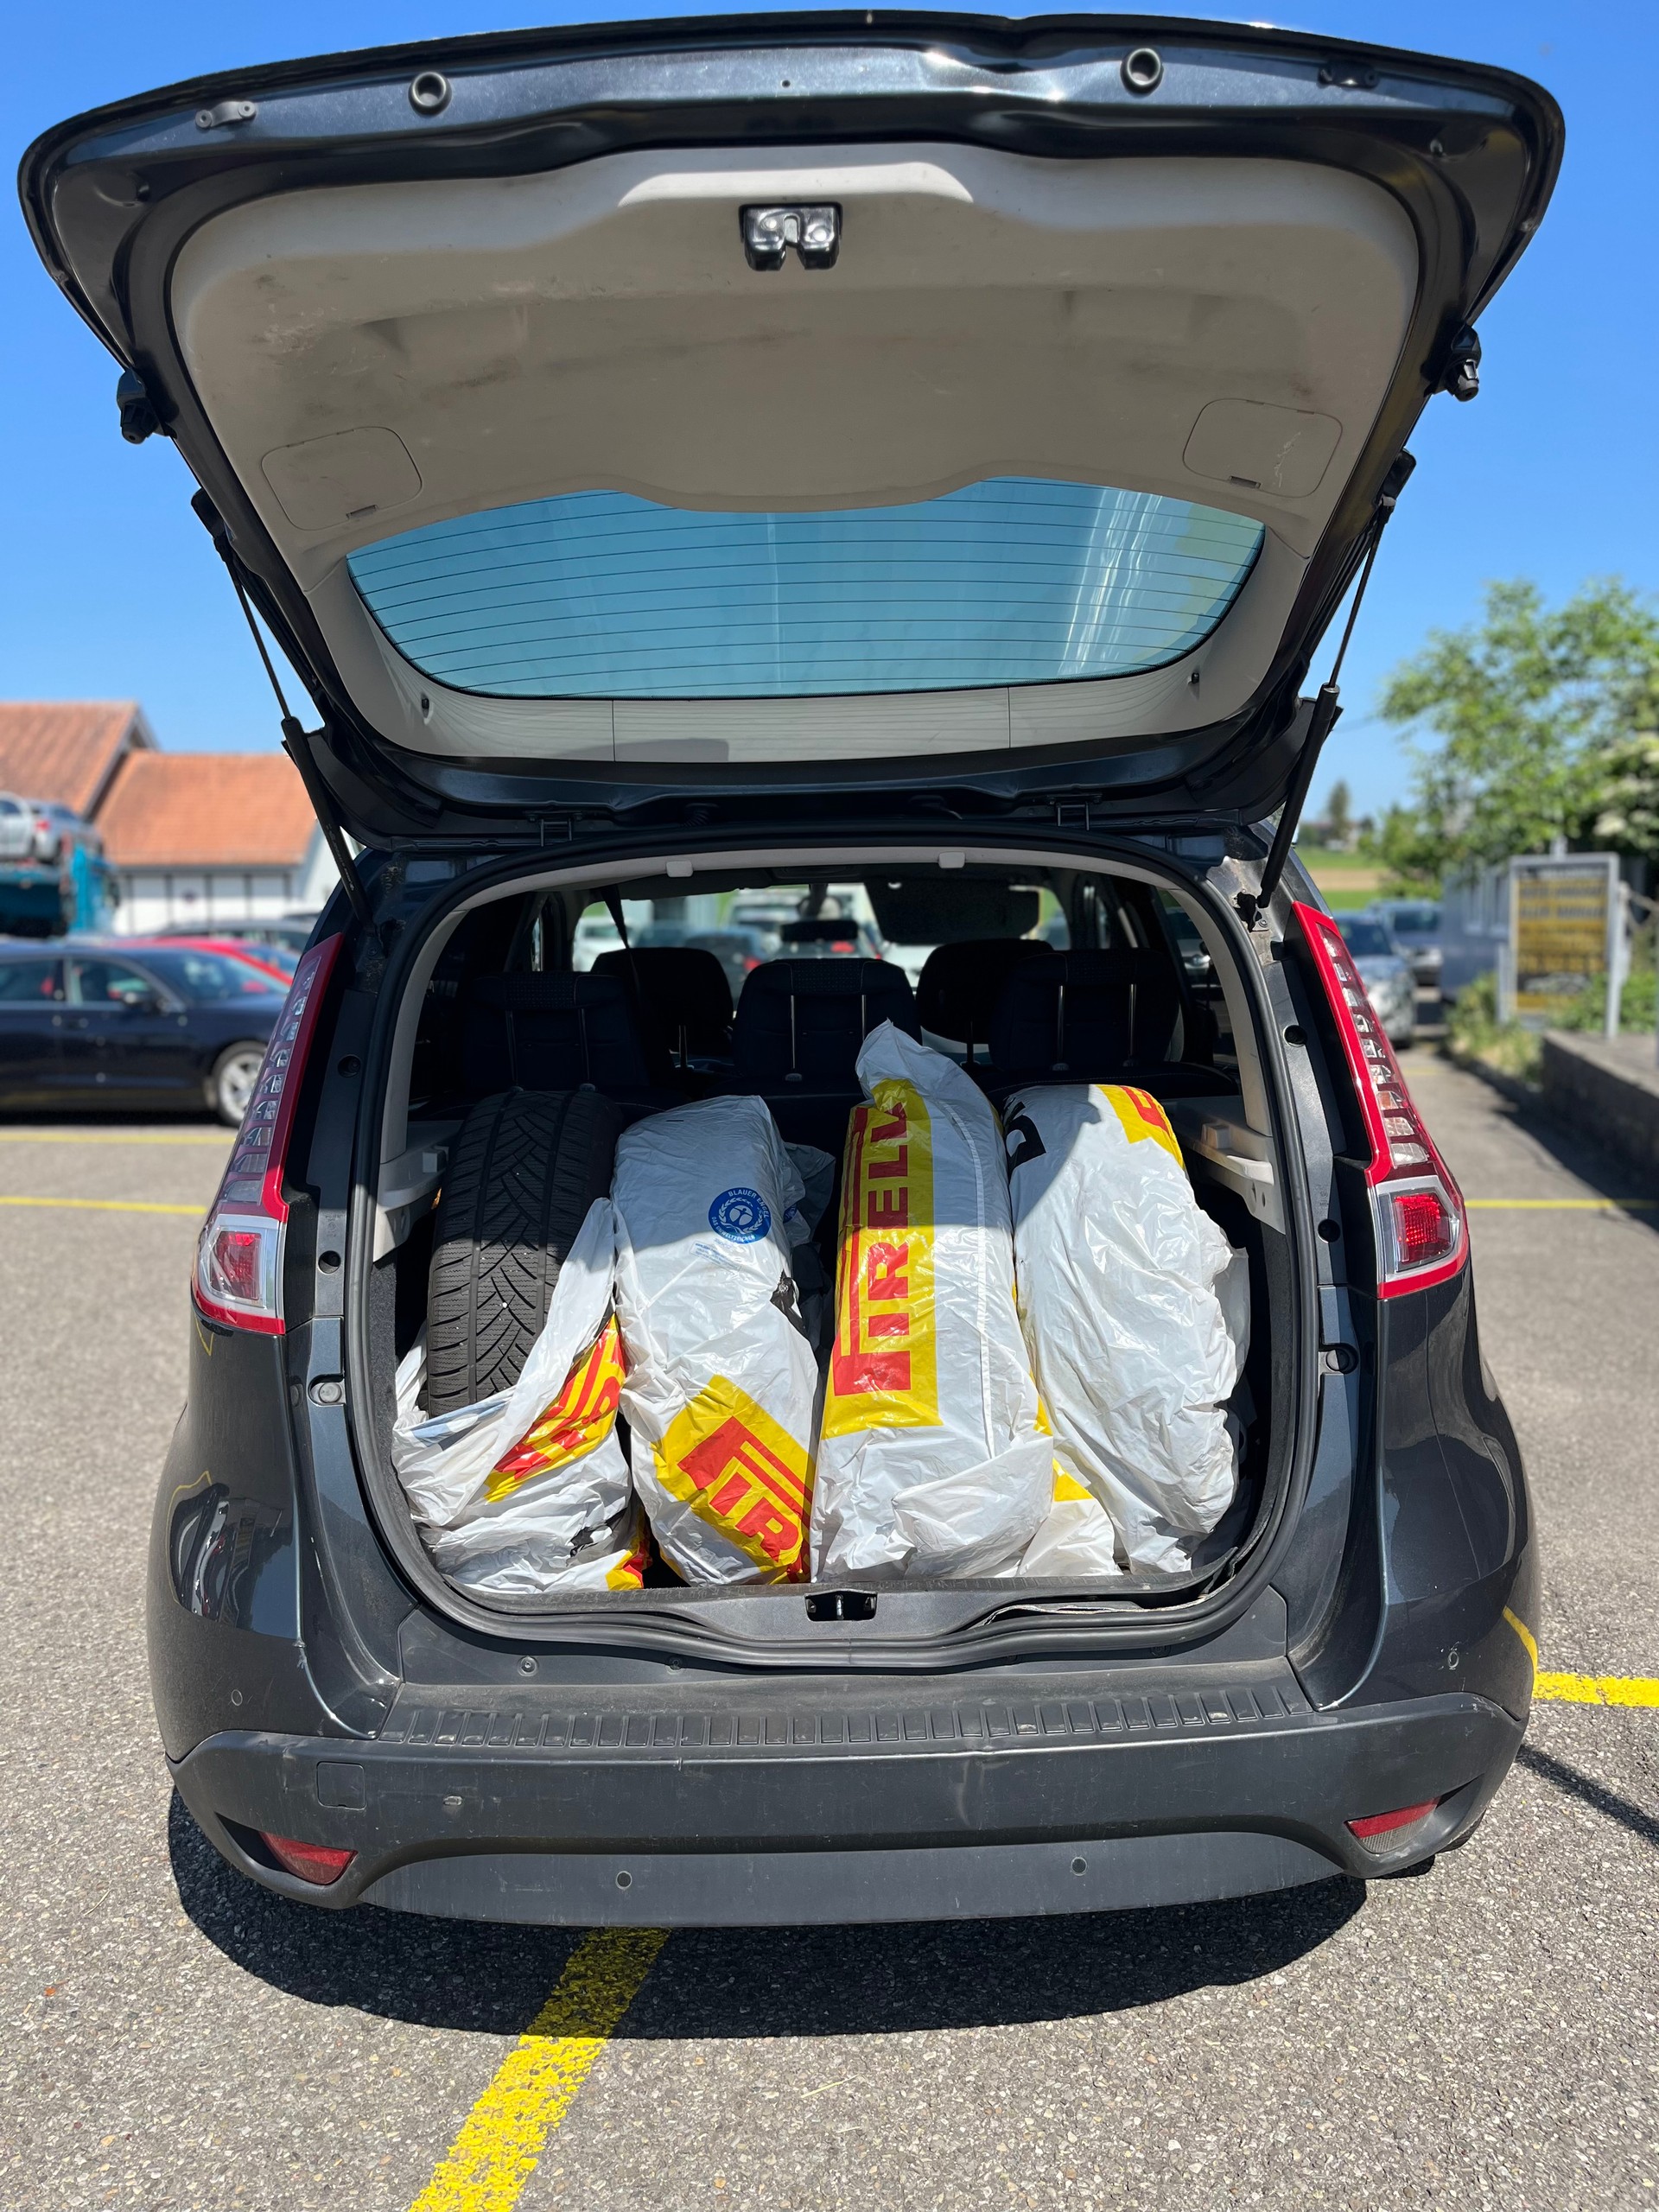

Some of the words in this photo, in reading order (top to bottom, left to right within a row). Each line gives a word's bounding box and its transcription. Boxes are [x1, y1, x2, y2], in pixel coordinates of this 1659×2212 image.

[728, 1189, 757, 1198] BLAUER
[756, 1198, 770, 1217] ENGEL
[677, 1415, 813, 1583] PIR
